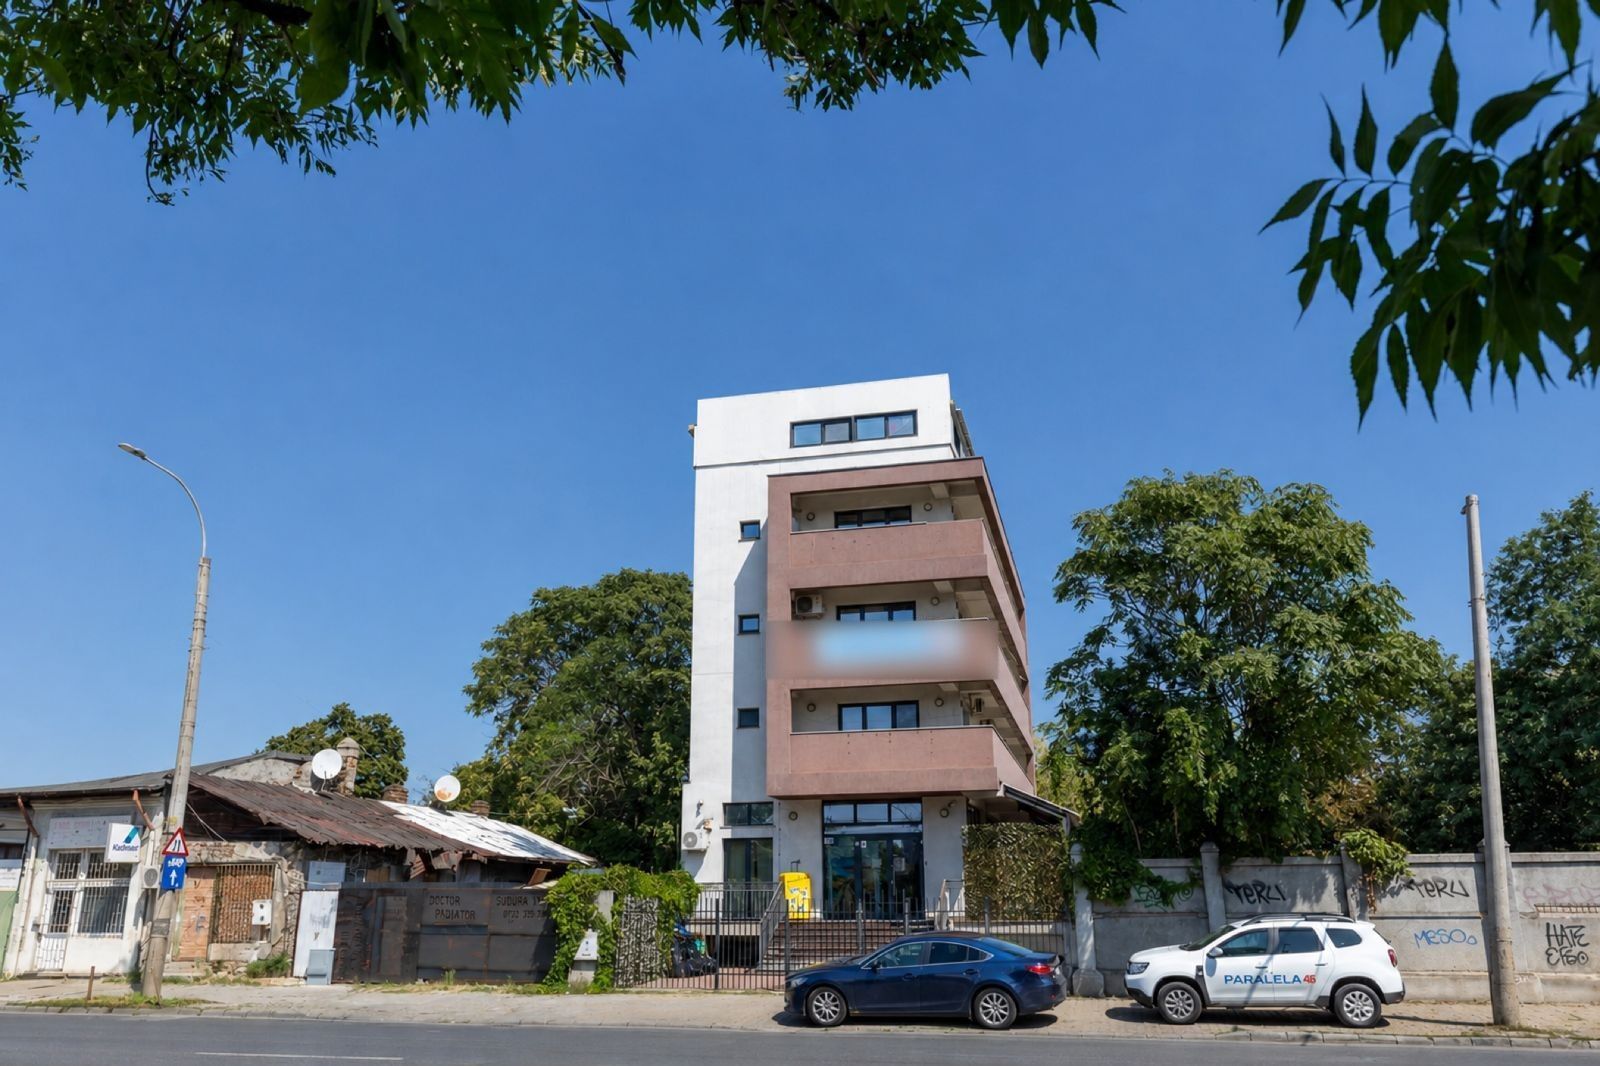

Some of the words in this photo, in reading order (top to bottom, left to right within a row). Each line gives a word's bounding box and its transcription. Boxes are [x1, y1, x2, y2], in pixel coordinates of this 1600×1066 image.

[429, 895, 461, 906] DOCTOR
[1546, 922, 1590, 948] HATE
[1224, 975, 1302, 984] PARALELA
